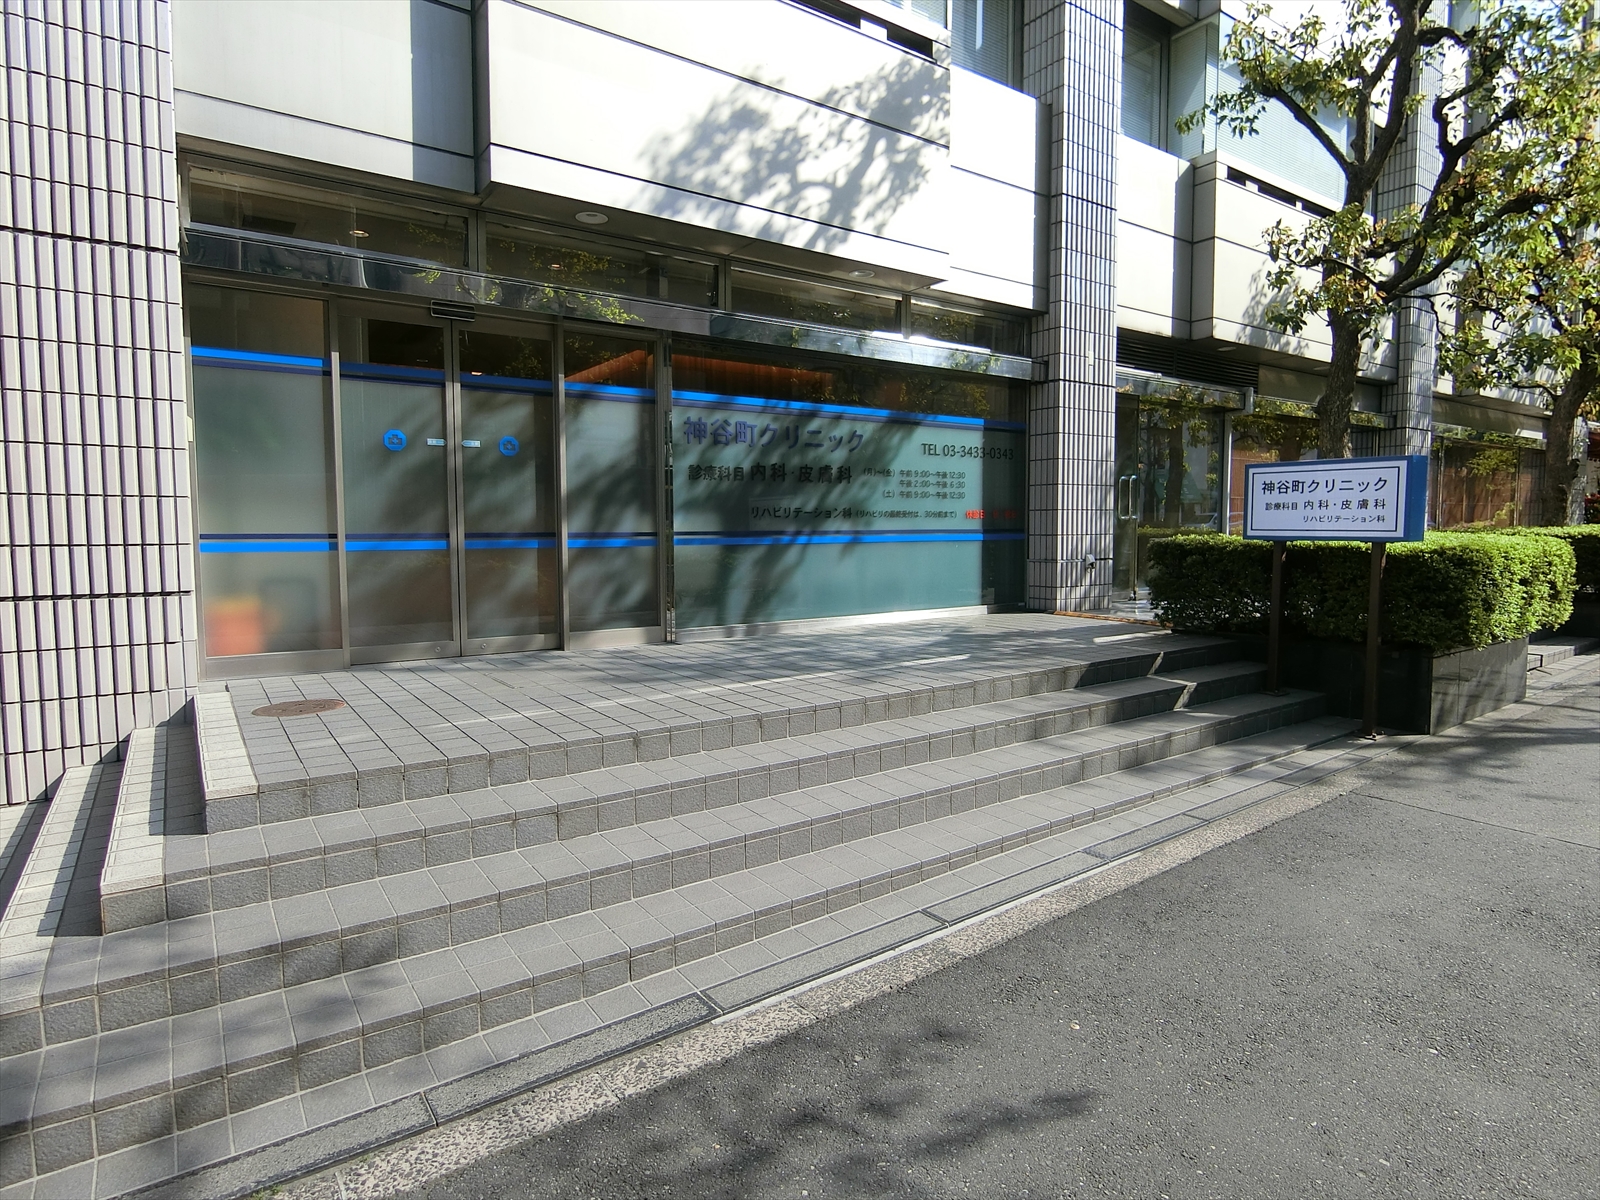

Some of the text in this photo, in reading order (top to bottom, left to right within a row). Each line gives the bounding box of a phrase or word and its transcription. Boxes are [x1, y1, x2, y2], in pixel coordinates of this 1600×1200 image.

[683, 416, 865, 453] 神谷町クリニック
[921, 443, 1014, 460] TEL 03-3433-0343
[688, 462, 852, 484] 診療科目 内科・皮膚科
[1261, 477, 1388, 495] 神谷町クリニック
[751, 506, 852, 519] リハビリテーション科
[1265, 498, 1386, 511] 診療科目 内科・皮膚科
[1303, 514, 1386, 523] リハビリテーション科
